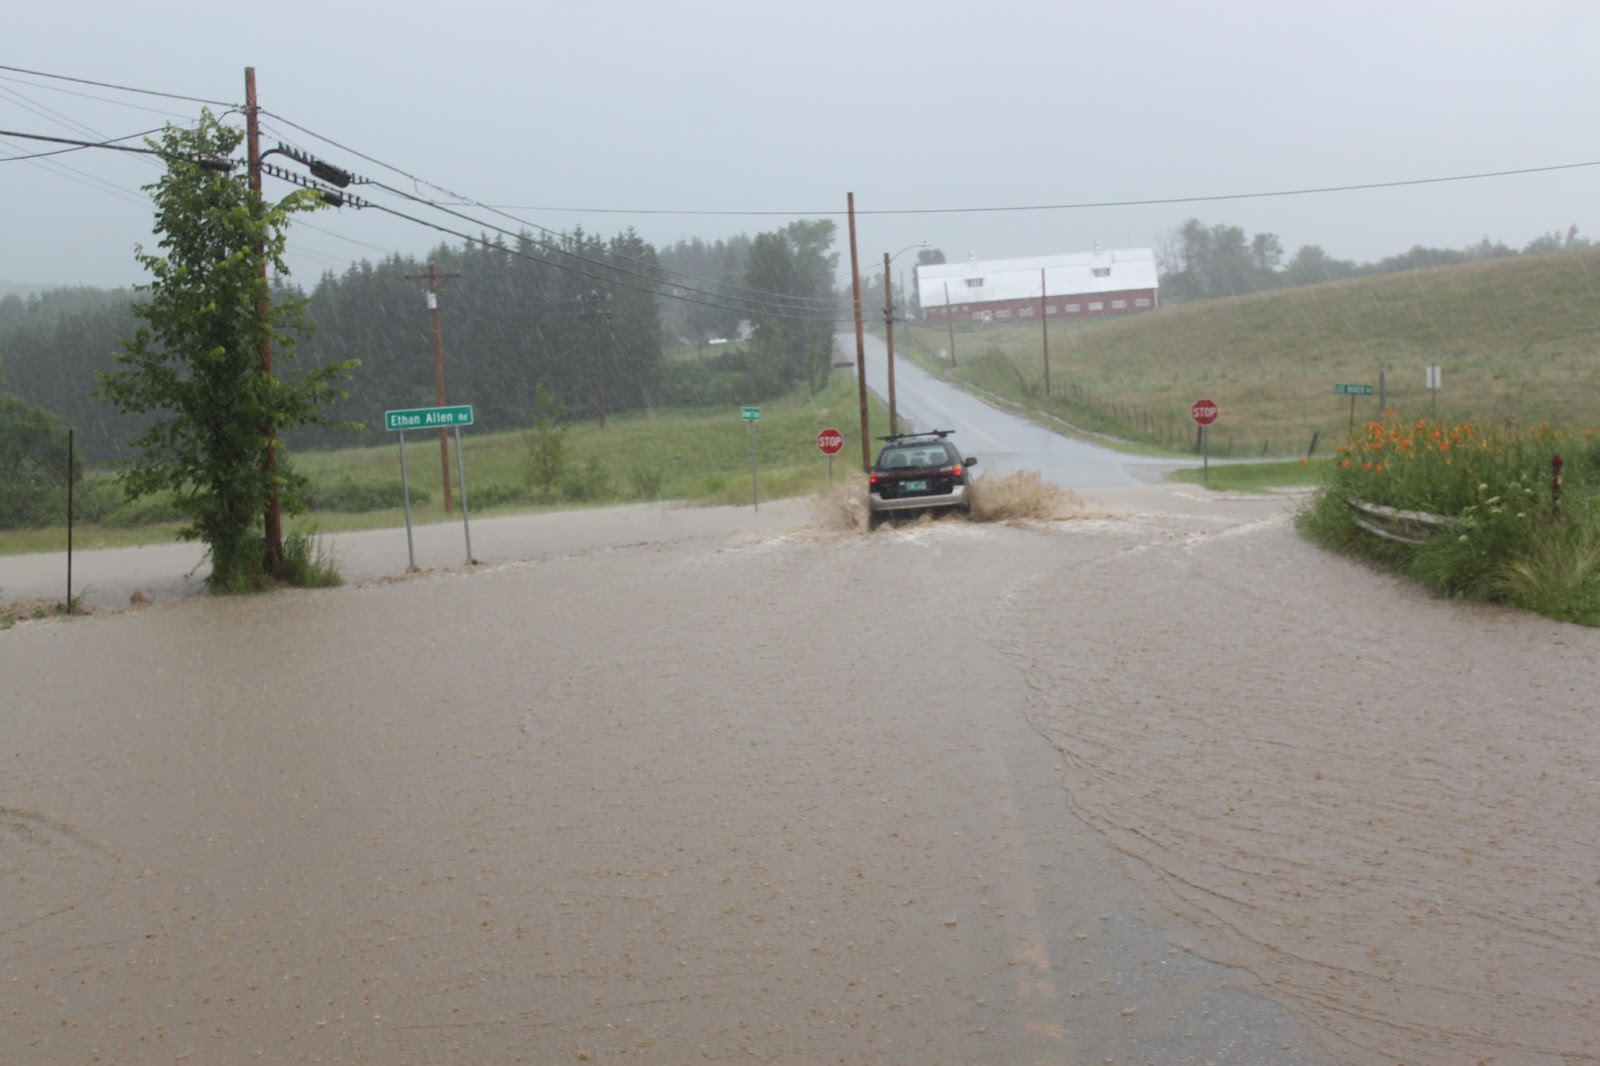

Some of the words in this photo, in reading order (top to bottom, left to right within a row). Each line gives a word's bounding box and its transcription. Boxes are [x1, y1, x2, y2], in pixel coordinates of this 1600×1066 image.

[1193, 406, 1216, 417] STOP
[391, 415, 420, 426] Ethan
[426, 412, 453, 424] Allen
[458, 413, 468, 421] Rd
[819, 436, 841, 447] STOP
